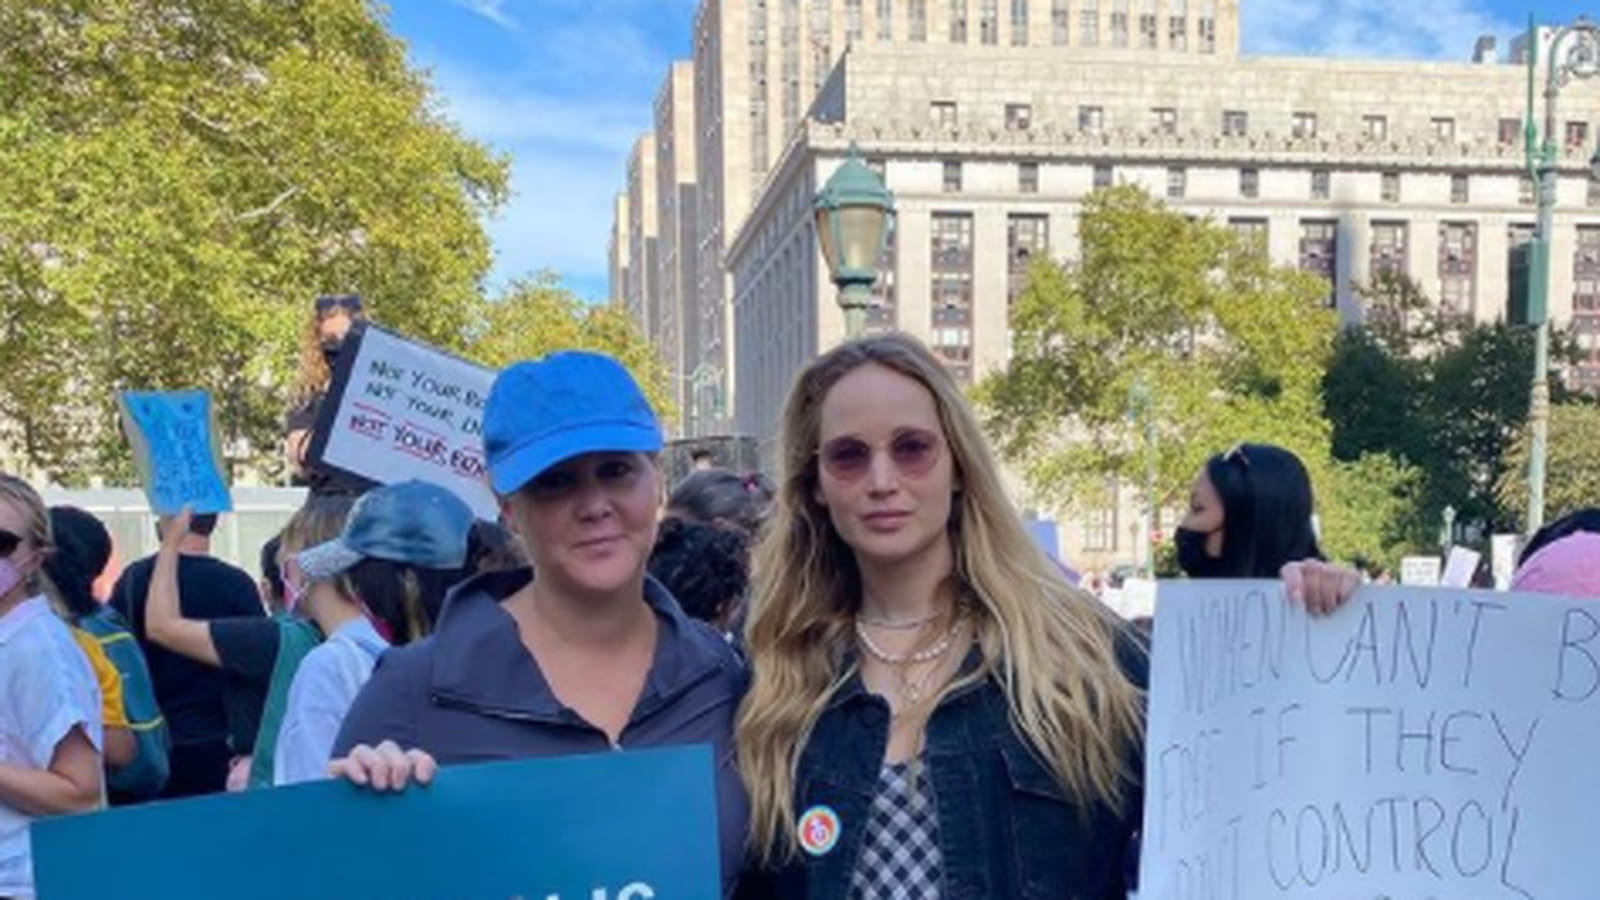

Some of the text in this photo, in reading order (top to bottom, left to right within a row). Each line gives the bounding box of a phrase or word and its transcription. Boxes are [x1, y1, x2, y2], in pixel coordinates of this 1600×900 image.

[411, 371, 461, 402] YOUR
[1249, 702, 1301, 789] IF
[1345, 708, 1540, 813] THEY
[1265, 797, 1535, 900] CONTROL
